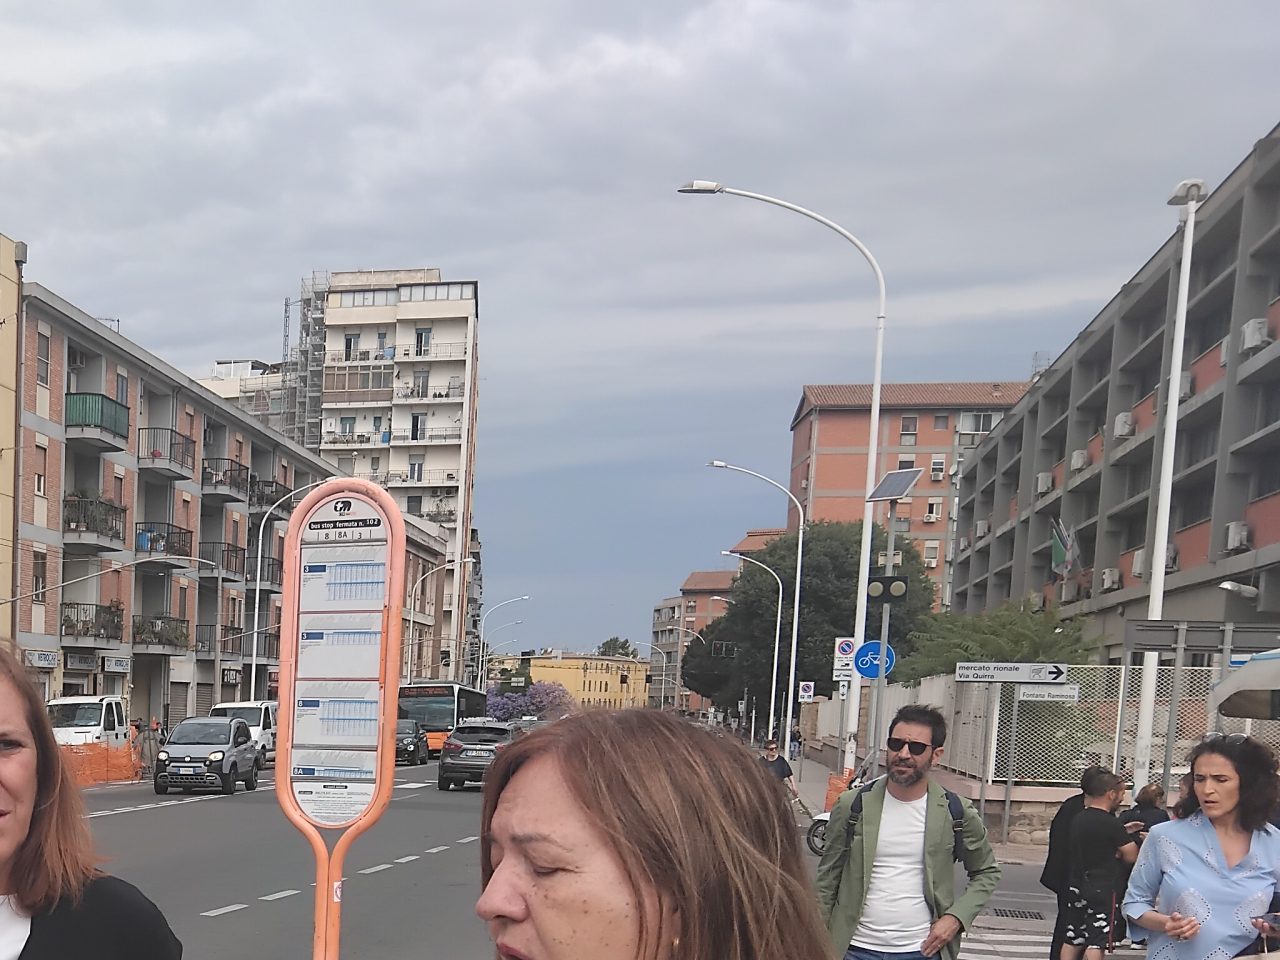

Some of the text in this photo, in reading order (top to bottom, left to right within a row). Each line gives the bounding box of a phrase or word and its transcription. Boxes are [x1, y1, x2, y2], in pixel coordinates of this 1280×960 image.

[324, 531, 363, 540] 8 8A 3
[304, 565, 309, 573] 3
[302, 632, 307, 640] 3
[993, 664, 1020, 672] rionale
